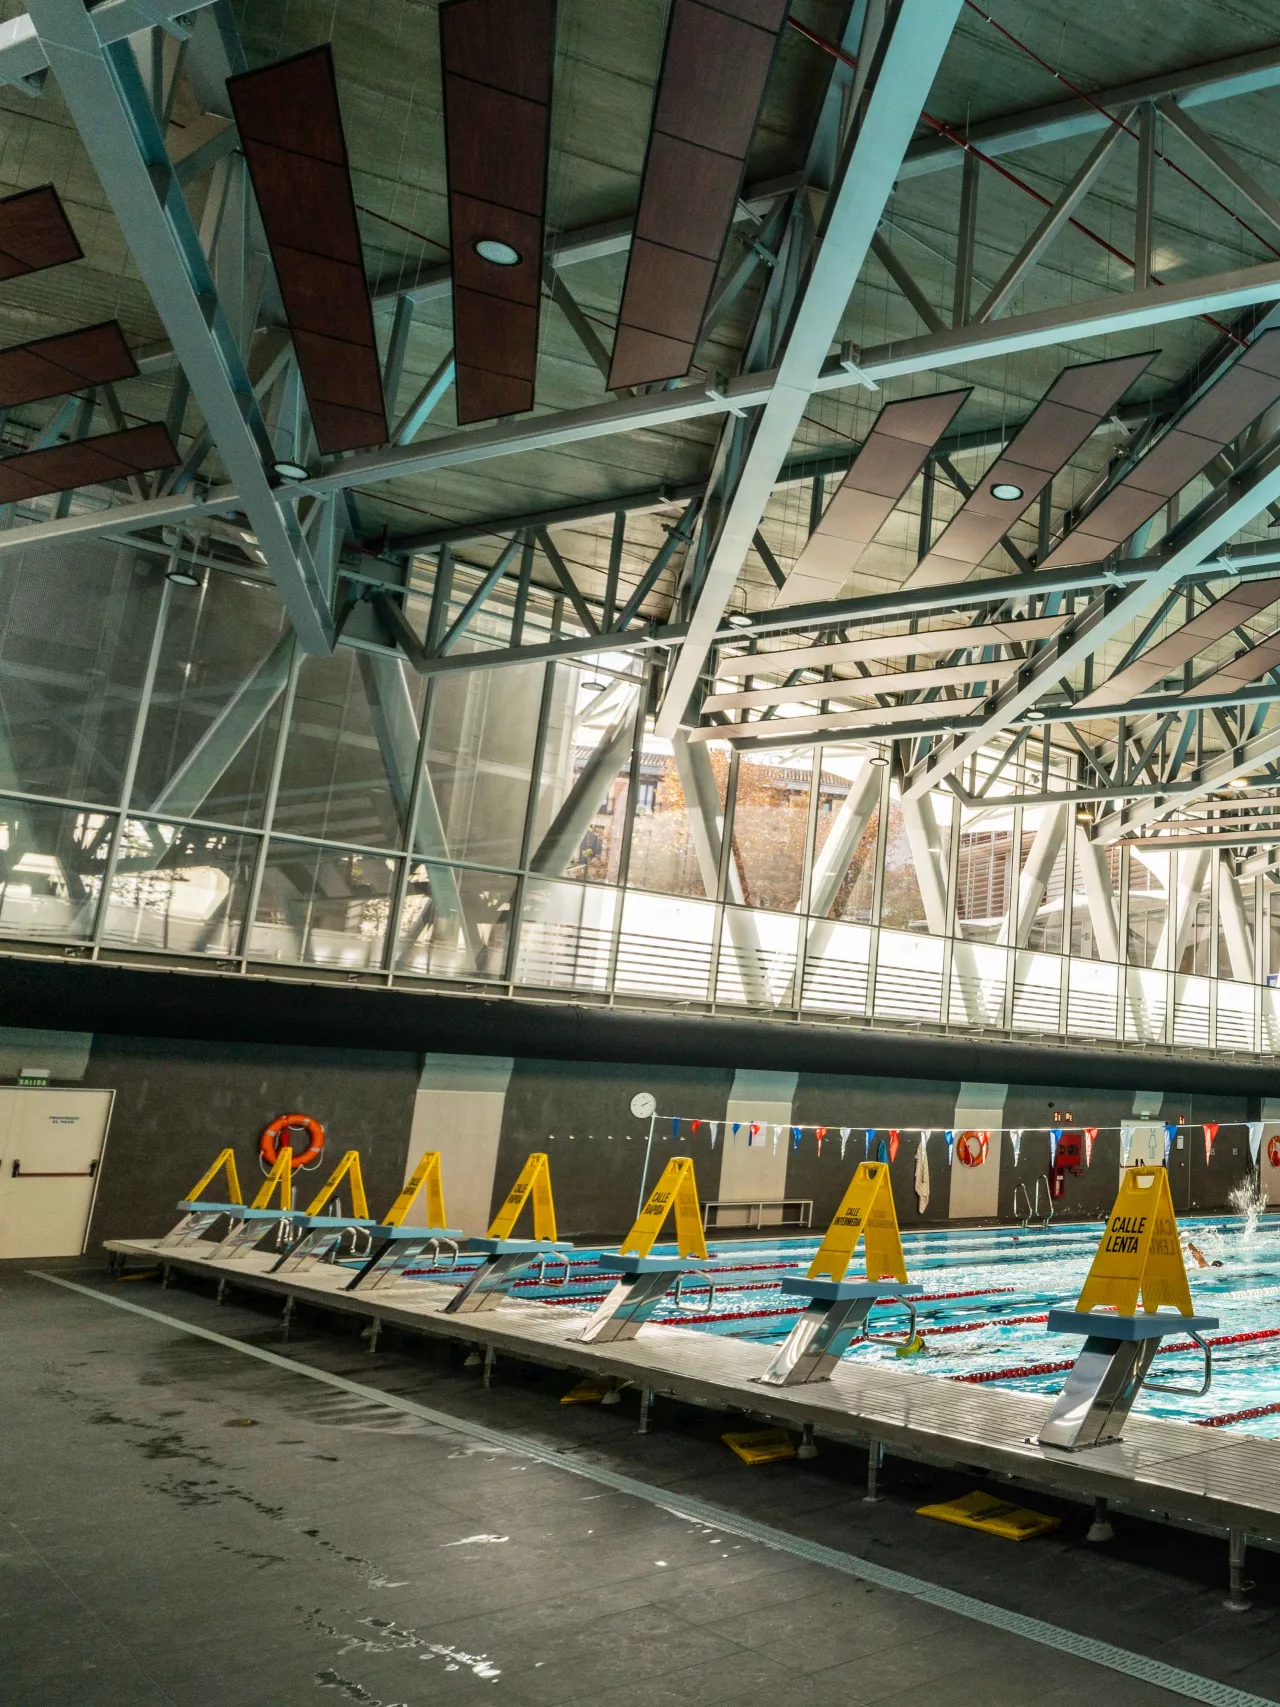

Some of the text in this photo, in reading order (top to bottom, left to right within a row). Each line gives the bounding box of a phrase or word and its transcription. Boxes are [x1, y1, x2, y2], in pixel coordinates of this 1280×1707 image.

[514, 1183, 528, 1193] CALLE
[651, 1192, 671, 1203] CALLE
[846, 1207, 861, 1217] CALLE
[834, 1216, 862, 1227] INTERMEDIA
[1111, 1217, 1146, 1233] CALLE
[1105, 1236, 1138, 1253] LENTA
